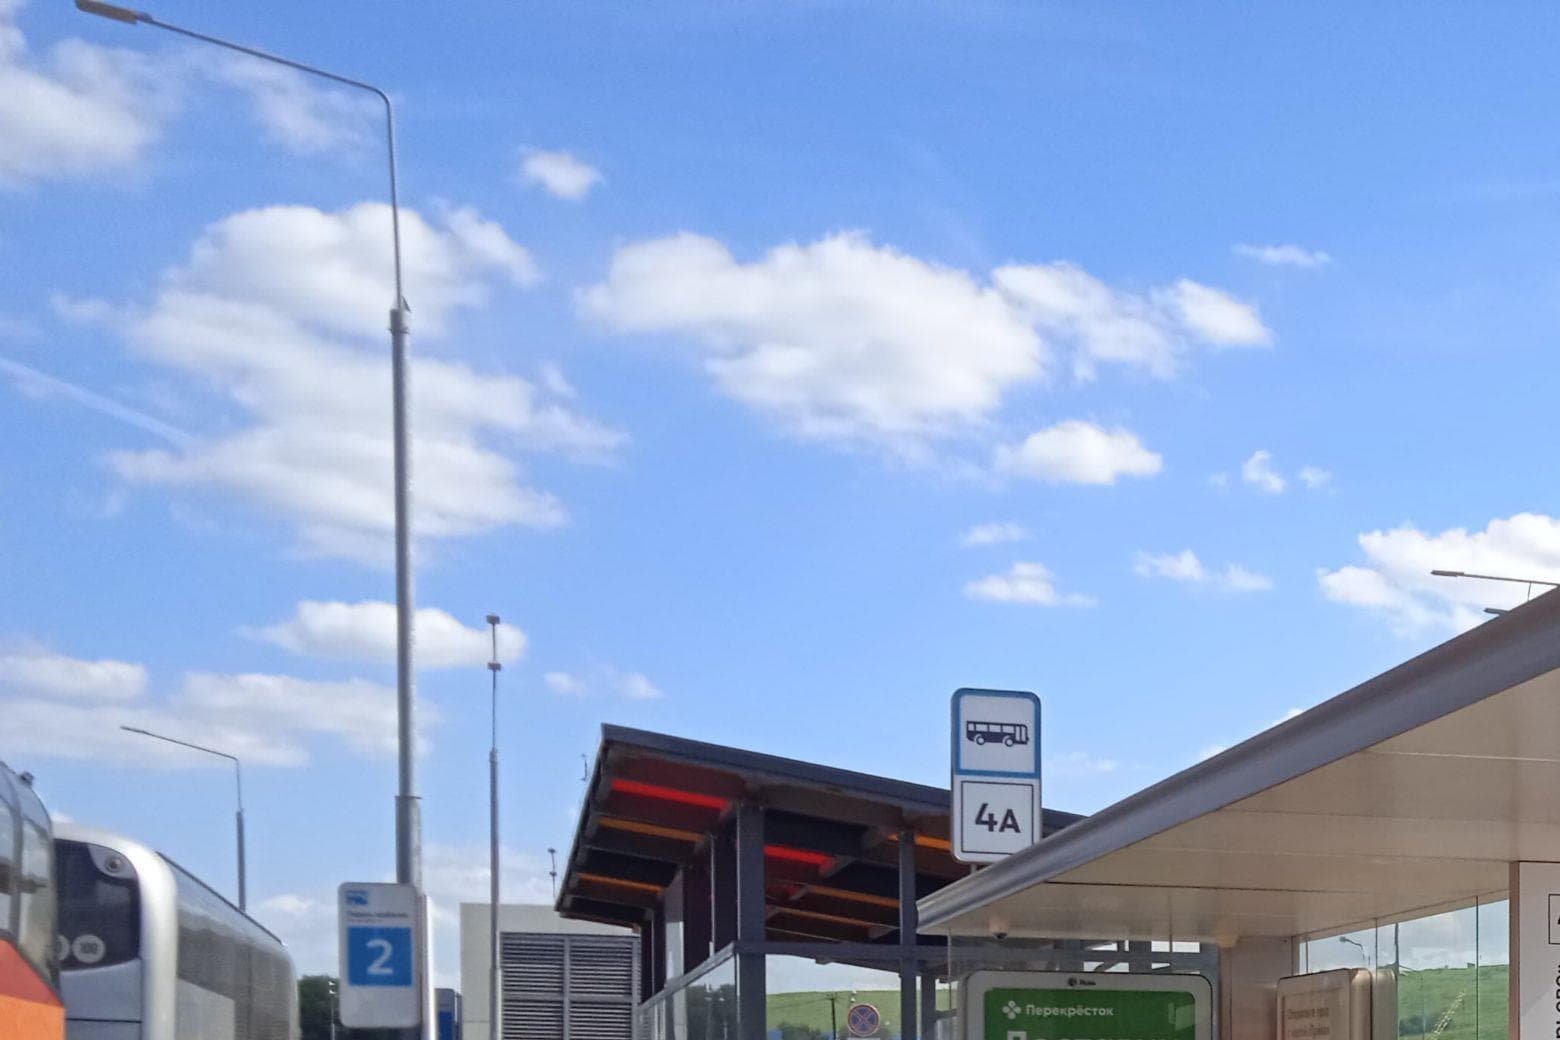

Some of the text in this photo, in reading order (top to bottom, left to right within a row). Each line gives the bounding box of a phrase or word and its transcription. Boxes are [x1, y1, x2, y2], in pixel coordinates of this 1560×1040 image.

[974, 802, 1021, 834] 4А
[365, 938, 394, 975] 2
[1026, 1003, 1115, 1019] Перекрёсток
